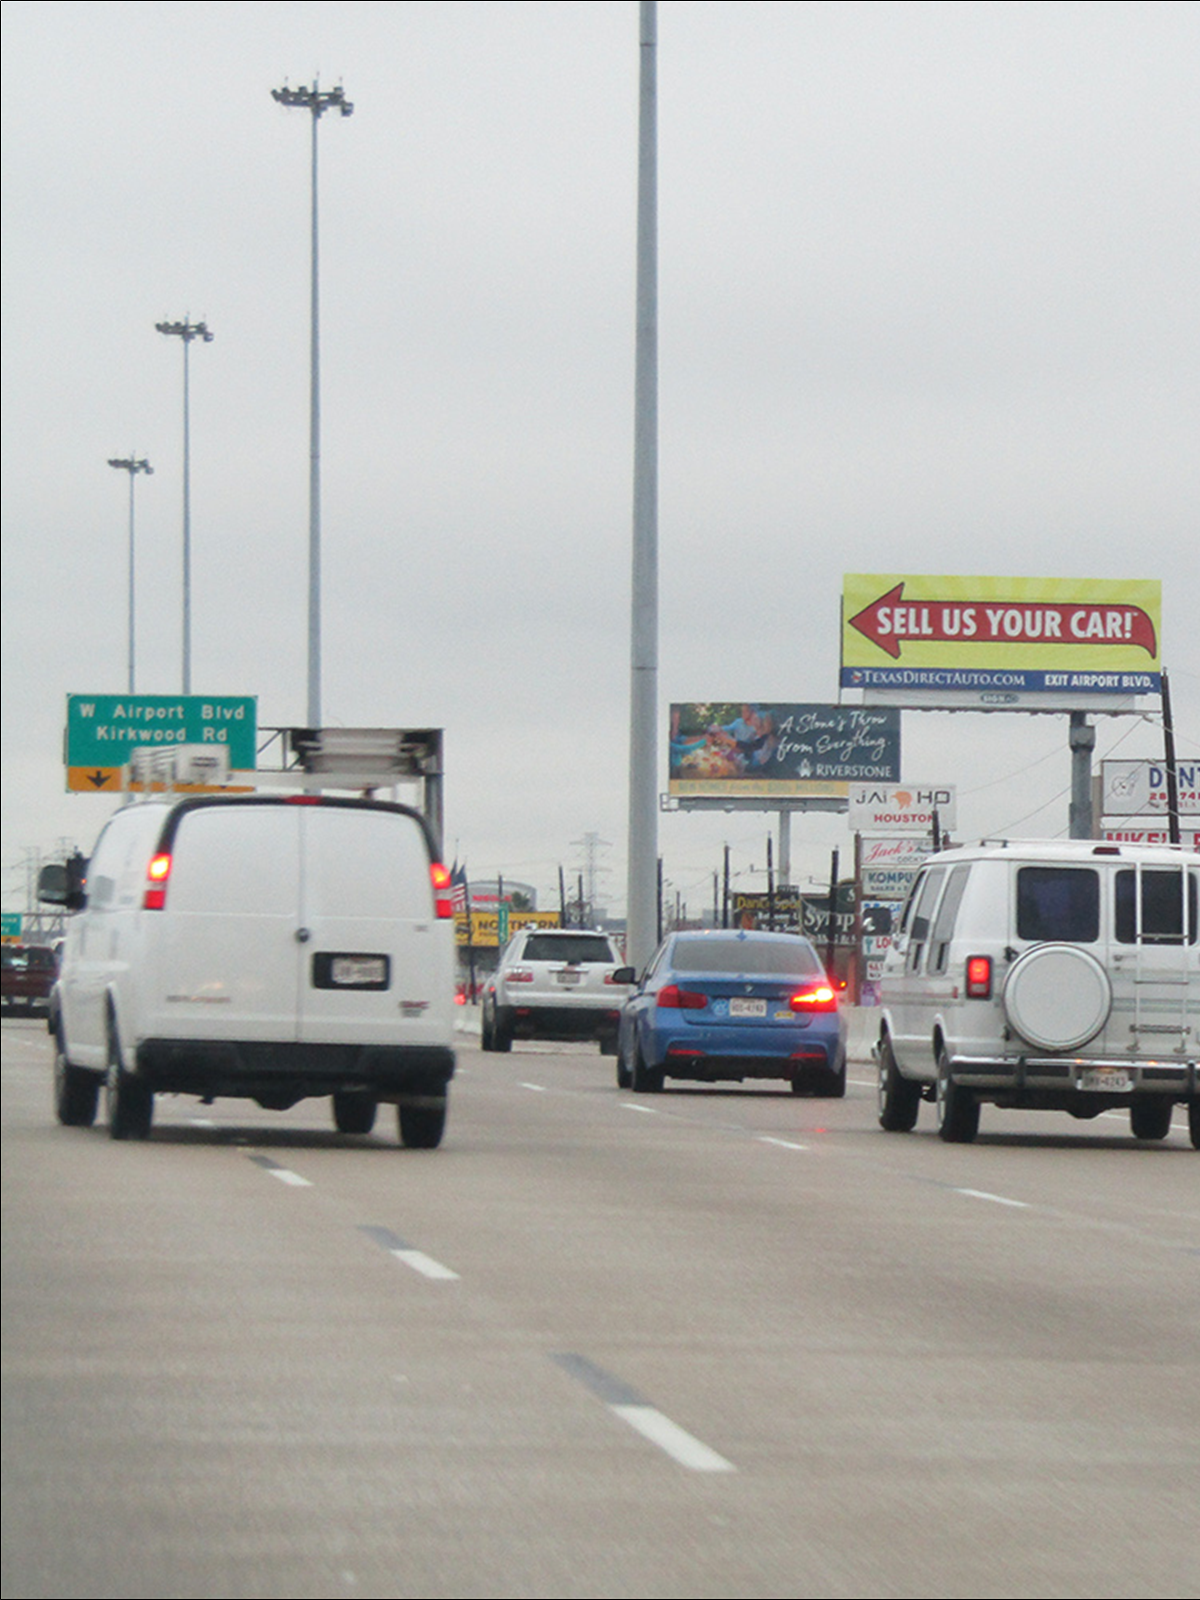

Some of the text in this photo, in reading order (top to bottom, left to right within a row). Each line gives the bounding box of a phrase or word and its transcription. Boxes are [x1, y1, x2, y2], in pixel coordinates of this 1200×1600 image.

[877, 608, 934, 636] SELL
[942, 608, 977, 636] US
[986, 609, 1061, 637] YOUR
[1045, 675, 1154, 688] EXIT AIRPORT BLVD.
[80, 704, 246, 721] W Airport Blvd
[778, 710, 887, 735] A Stone's Throw
[97, 726, 228, 741] Kirkwood Rd
[776, 737, 813, 761] from
[816, 765, 893, 778] RIVERSTONE
